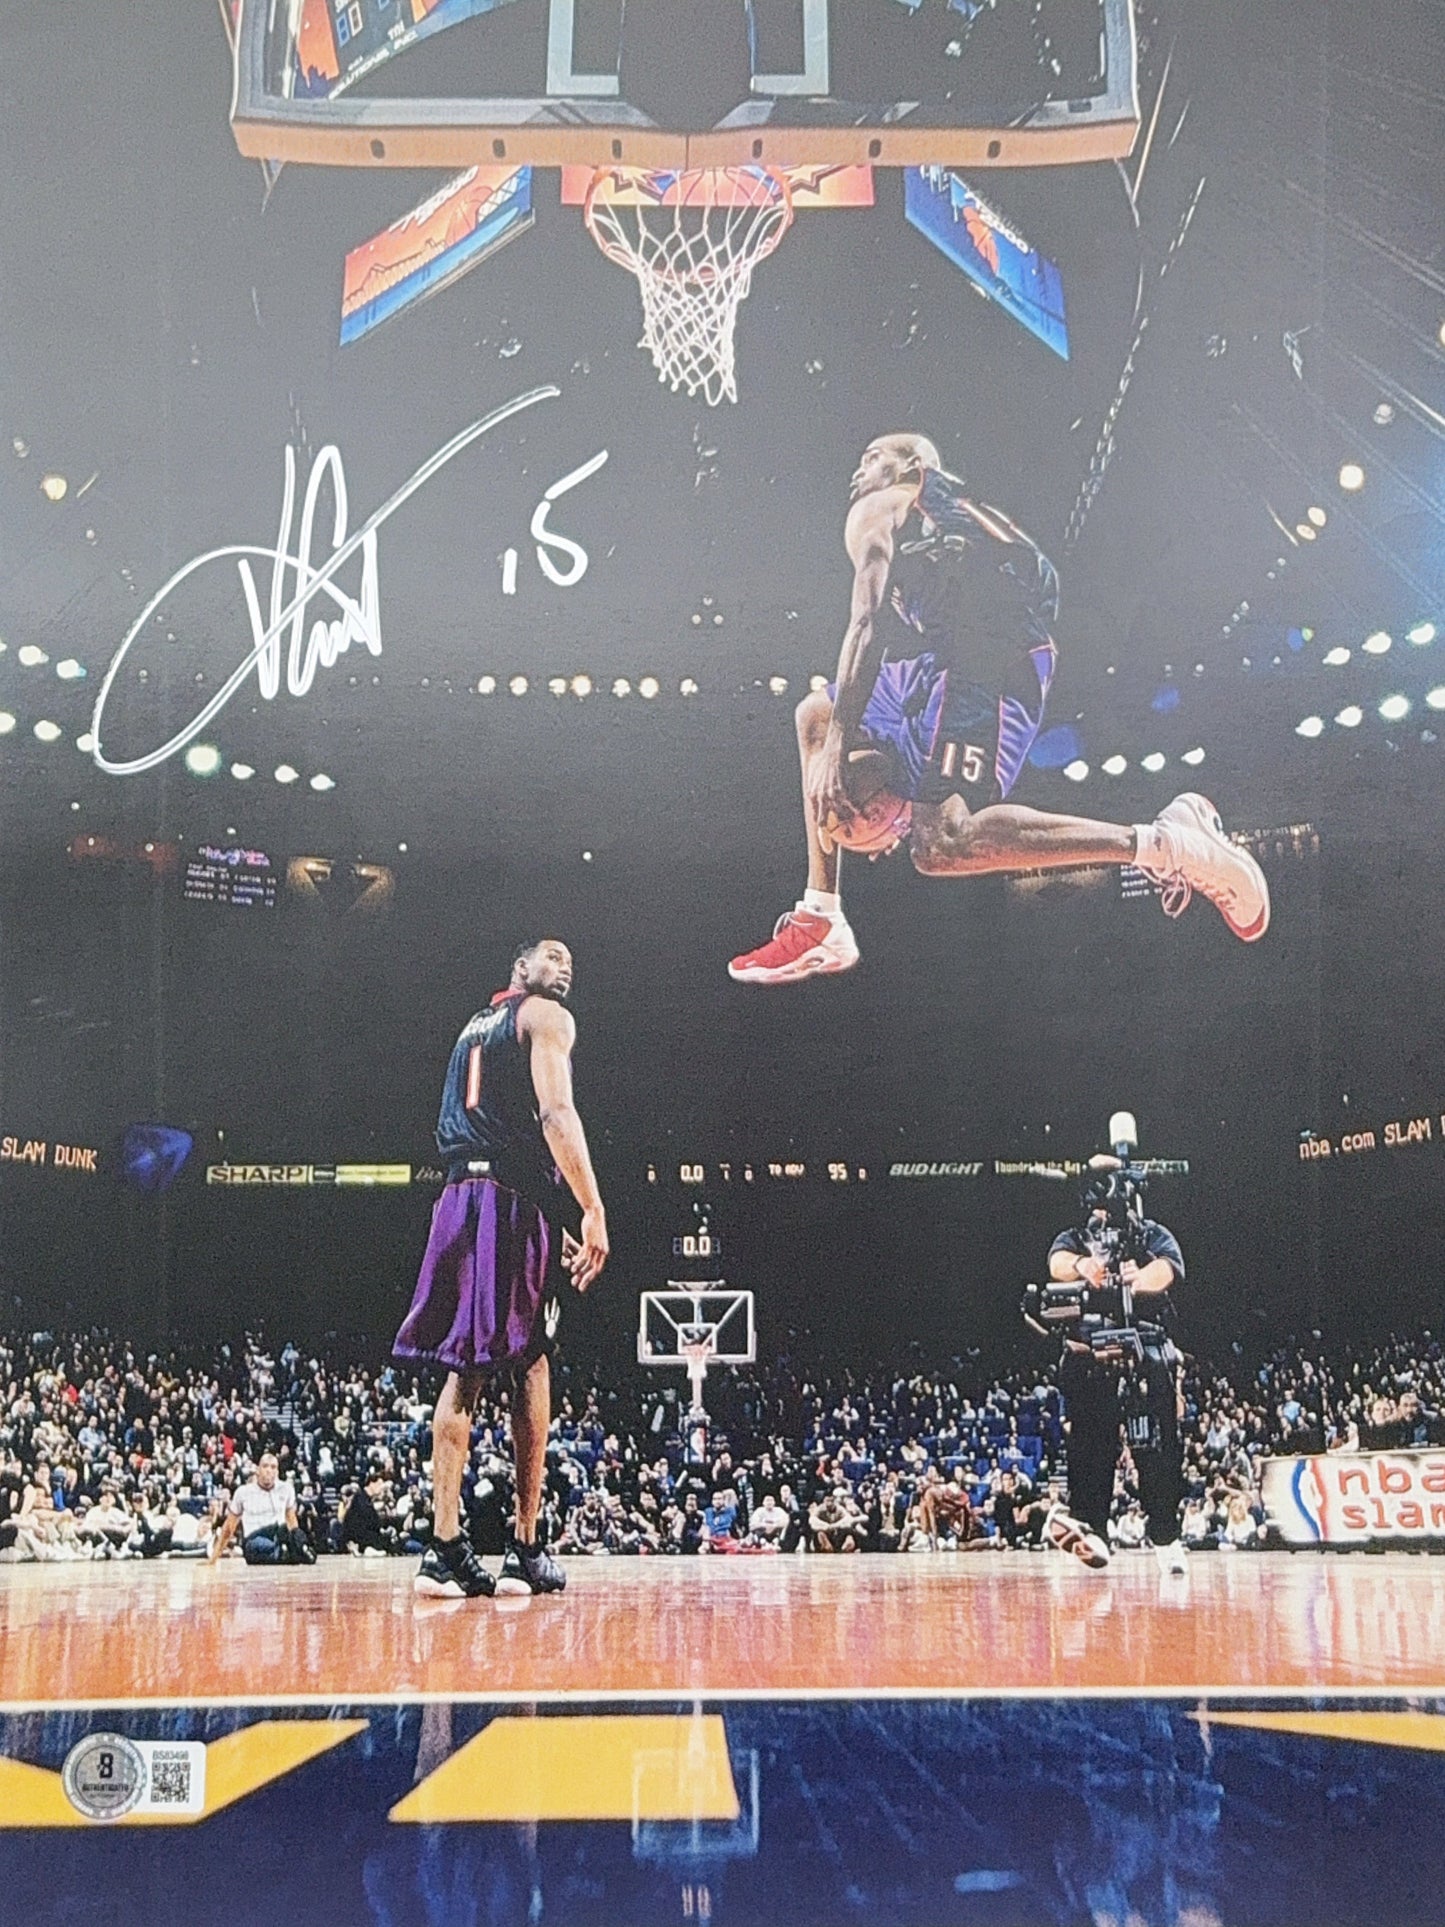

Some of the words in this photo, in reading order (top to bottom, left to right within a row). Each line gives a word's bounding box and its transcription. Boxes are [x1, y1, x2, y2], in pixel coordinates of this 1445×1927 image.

[502, 451, 608, 595] 15
[941, 742, 985, 782] 15
[466, 1044, 482, 1109] 1
[1384, 1117, 1432, 1146] SLAM
[1, 1137, 46, 1163] SLAM
[54, 1144, 97, 1171] DUNK
[889, 1163, 930, 1176] BUD
[929, 1162, 984, 1175] LIGHT
[211, 1166, 303, 1181] SHARP
[683, 1236, 711, 1256] 0.0
[1338, 1459, 1445, 1495] nba
